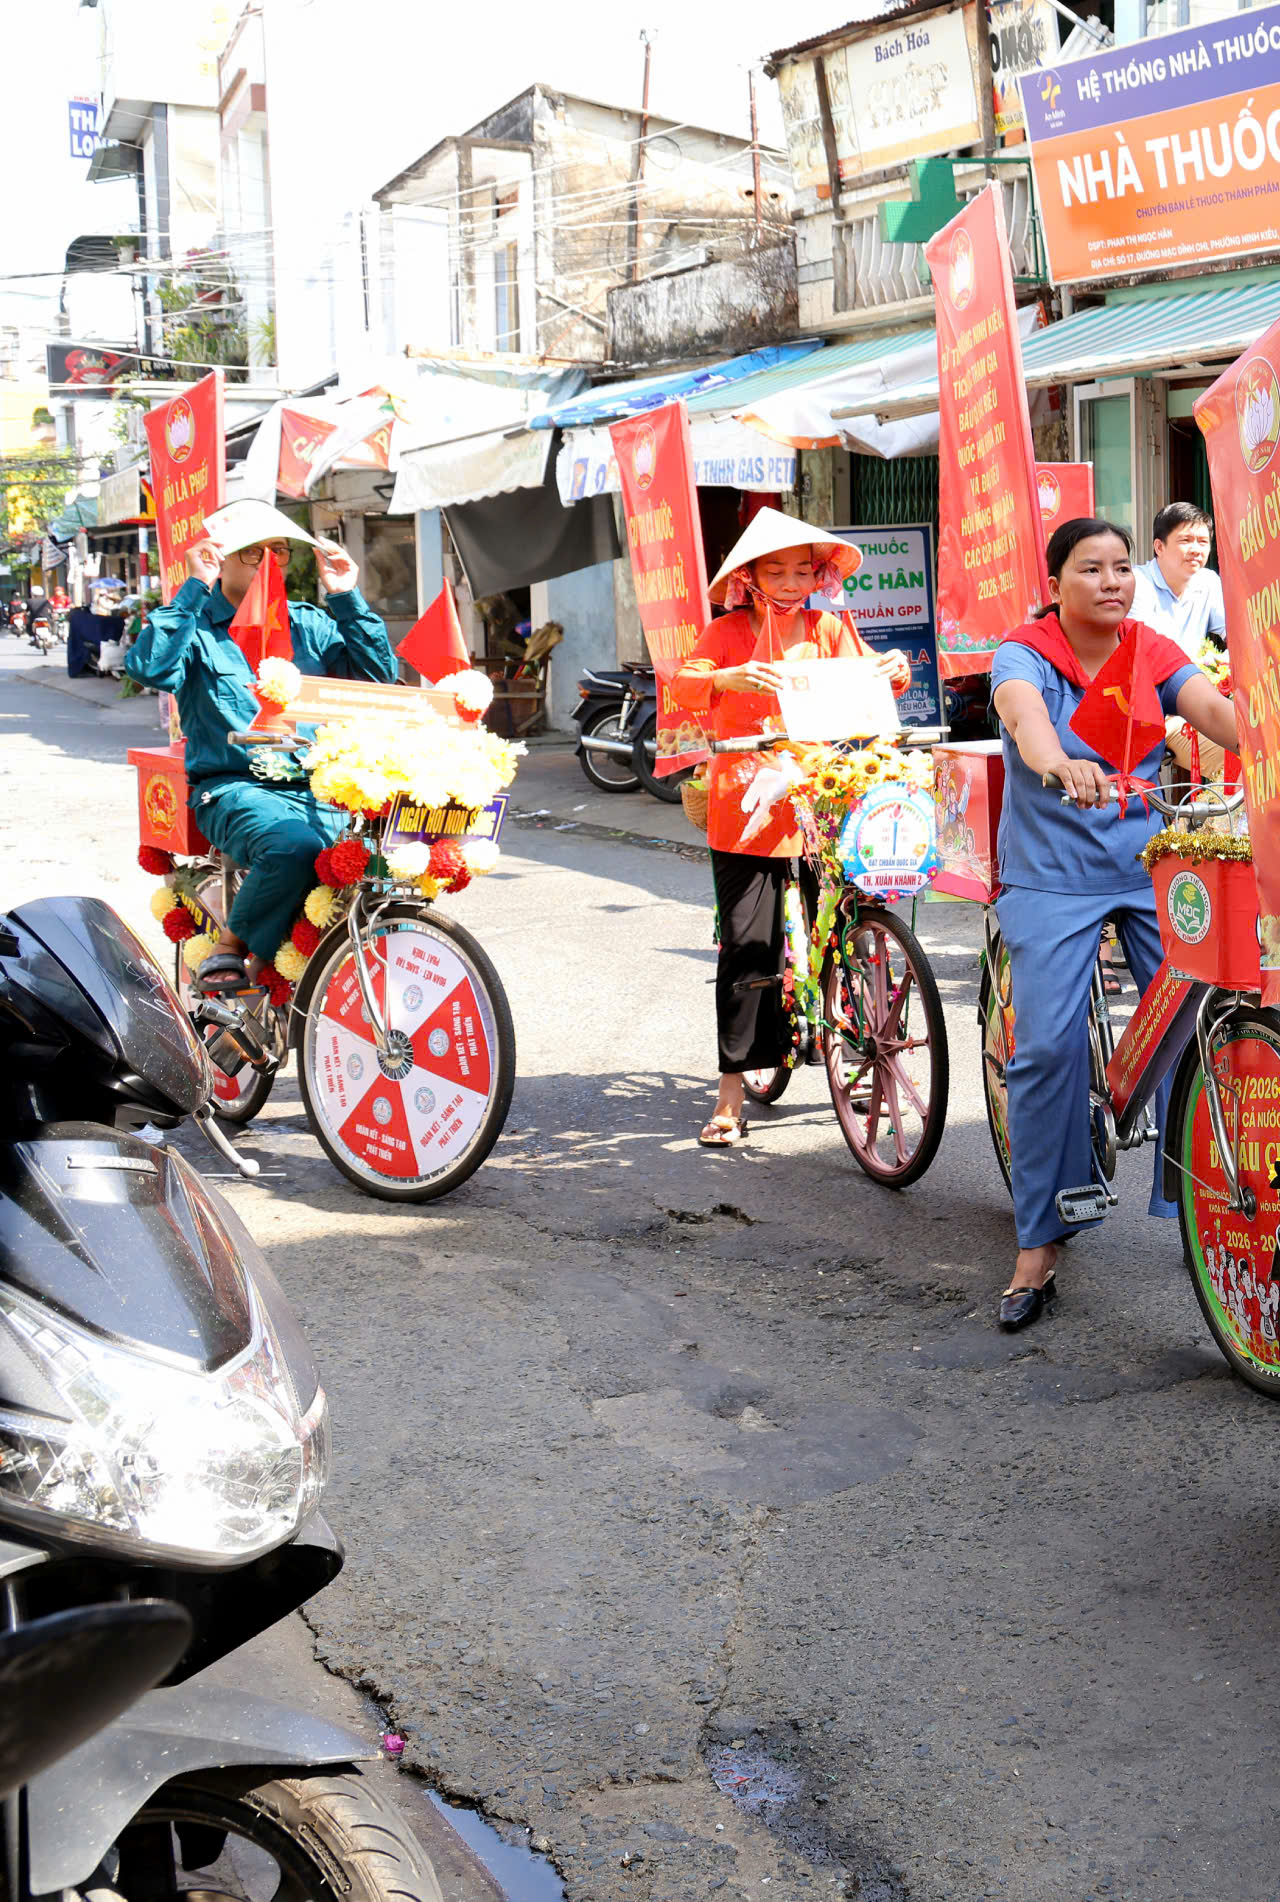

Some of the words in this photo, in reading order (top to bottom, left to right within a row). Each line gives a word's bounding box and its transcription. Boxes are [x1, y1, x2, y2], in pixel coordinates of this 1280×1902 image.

[874, 40, 903, 63] Bách
[906, 28, 931, 50] Hóa
[1077, 69, 1100, 102] HỆ
[1102, 58, 1167, 94] THỐNG
[1169, 40, 1211, 75] NHÀ
[1056, 131, 1144, 207] NHÀ
[738, 456, 765, 484] GAS
[1239, 491, 1267, 563] BẦU
[859, 537, 909, 556] THUỐC
[964, 543, 981, 571] CÁC
[878, 567, 924, 591] HÂN
[850, 601, 894, 620] CHUẨN
[897, 605, 922, 617] GPP
[1249, 668, 1267, 729] CÓ
[1247, 750, 1277, 814] TẬN
[863, 875, 873, 887] TH.
[875, 873, 893, 887] XUÂN
[894, 873, 916, 887] KHÁNH
[917, 875, 923, 886] 2
[1241, 1106, 1256, 1128] CẢ
[1226, 1229, 1251, 1249] 2026
